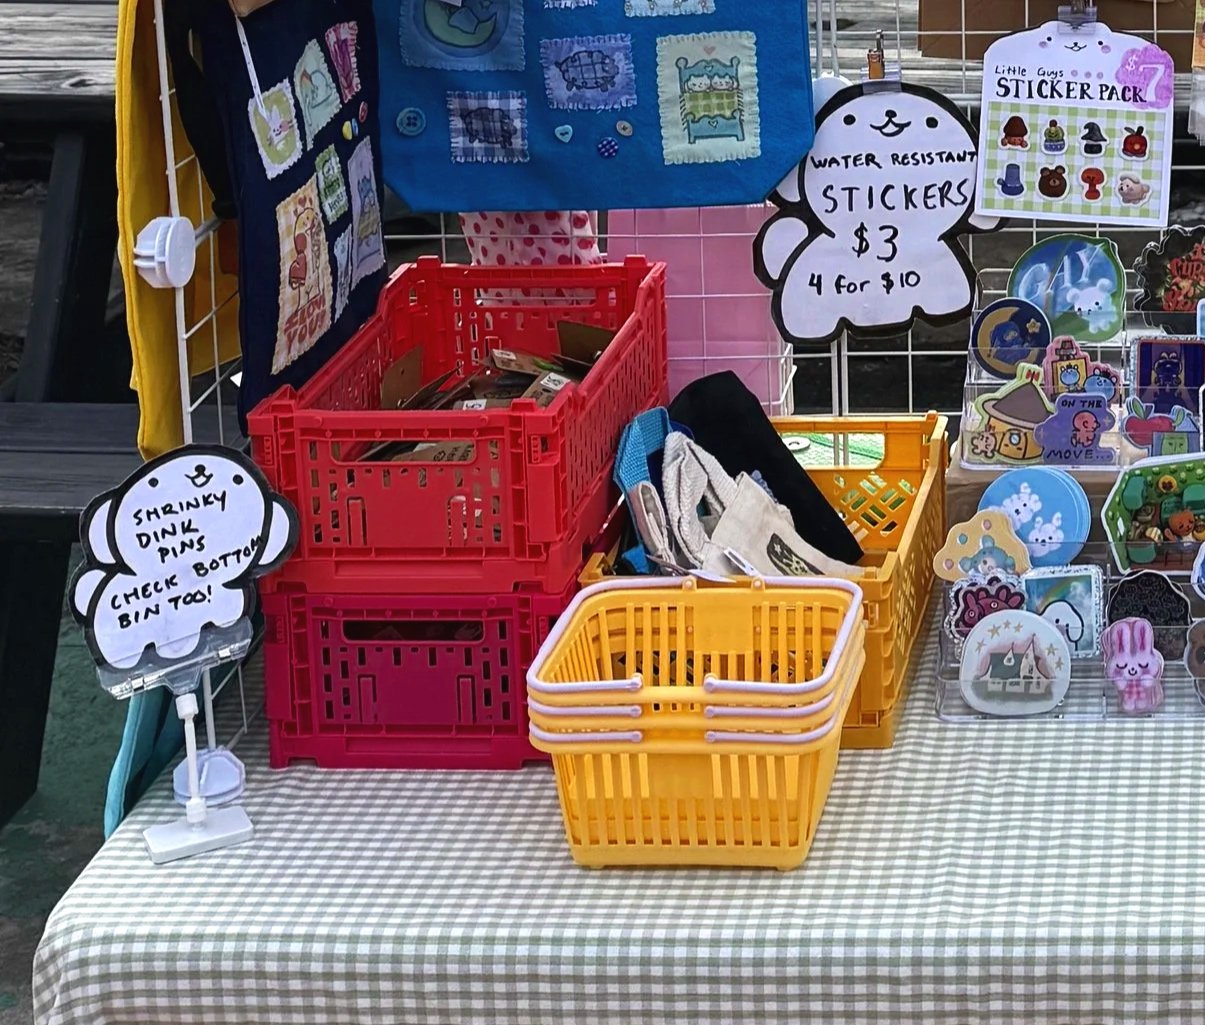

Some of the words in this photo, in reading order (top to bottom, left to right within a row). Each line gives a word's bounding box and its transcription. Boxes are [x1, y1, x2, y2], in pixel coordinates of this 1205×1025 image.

[995, 65, 1027, 75] Little
[1037, 67, 1064, 79] Guys
[996, 76, 1095, 100] STICKER
[1099, 83, 1148, 103] PACK
[810, 153, 883, 170] WATER
[891, 150, 978, 166] RESISTANT
[822, 178, 969, 214] STICKERS
[808, 273, 823, 296] 4
[834, 274, 871, 294] for
[881, 270, 921, 295] $10
[1061, 399, 1076, 408] ON
[1080, 399, 1103, 408] THE
[132, 490, 227, 526] SHRINKY
[136, 519, 200, 549] DINK
[157, 536, 206, 564] PINS
[110, 575, 178, 610] CHECK
[192, 535, 264, 577] BOTTOM
[118, 604, 160, 629] BIN
[168, 585, 213, 611] TOO!
